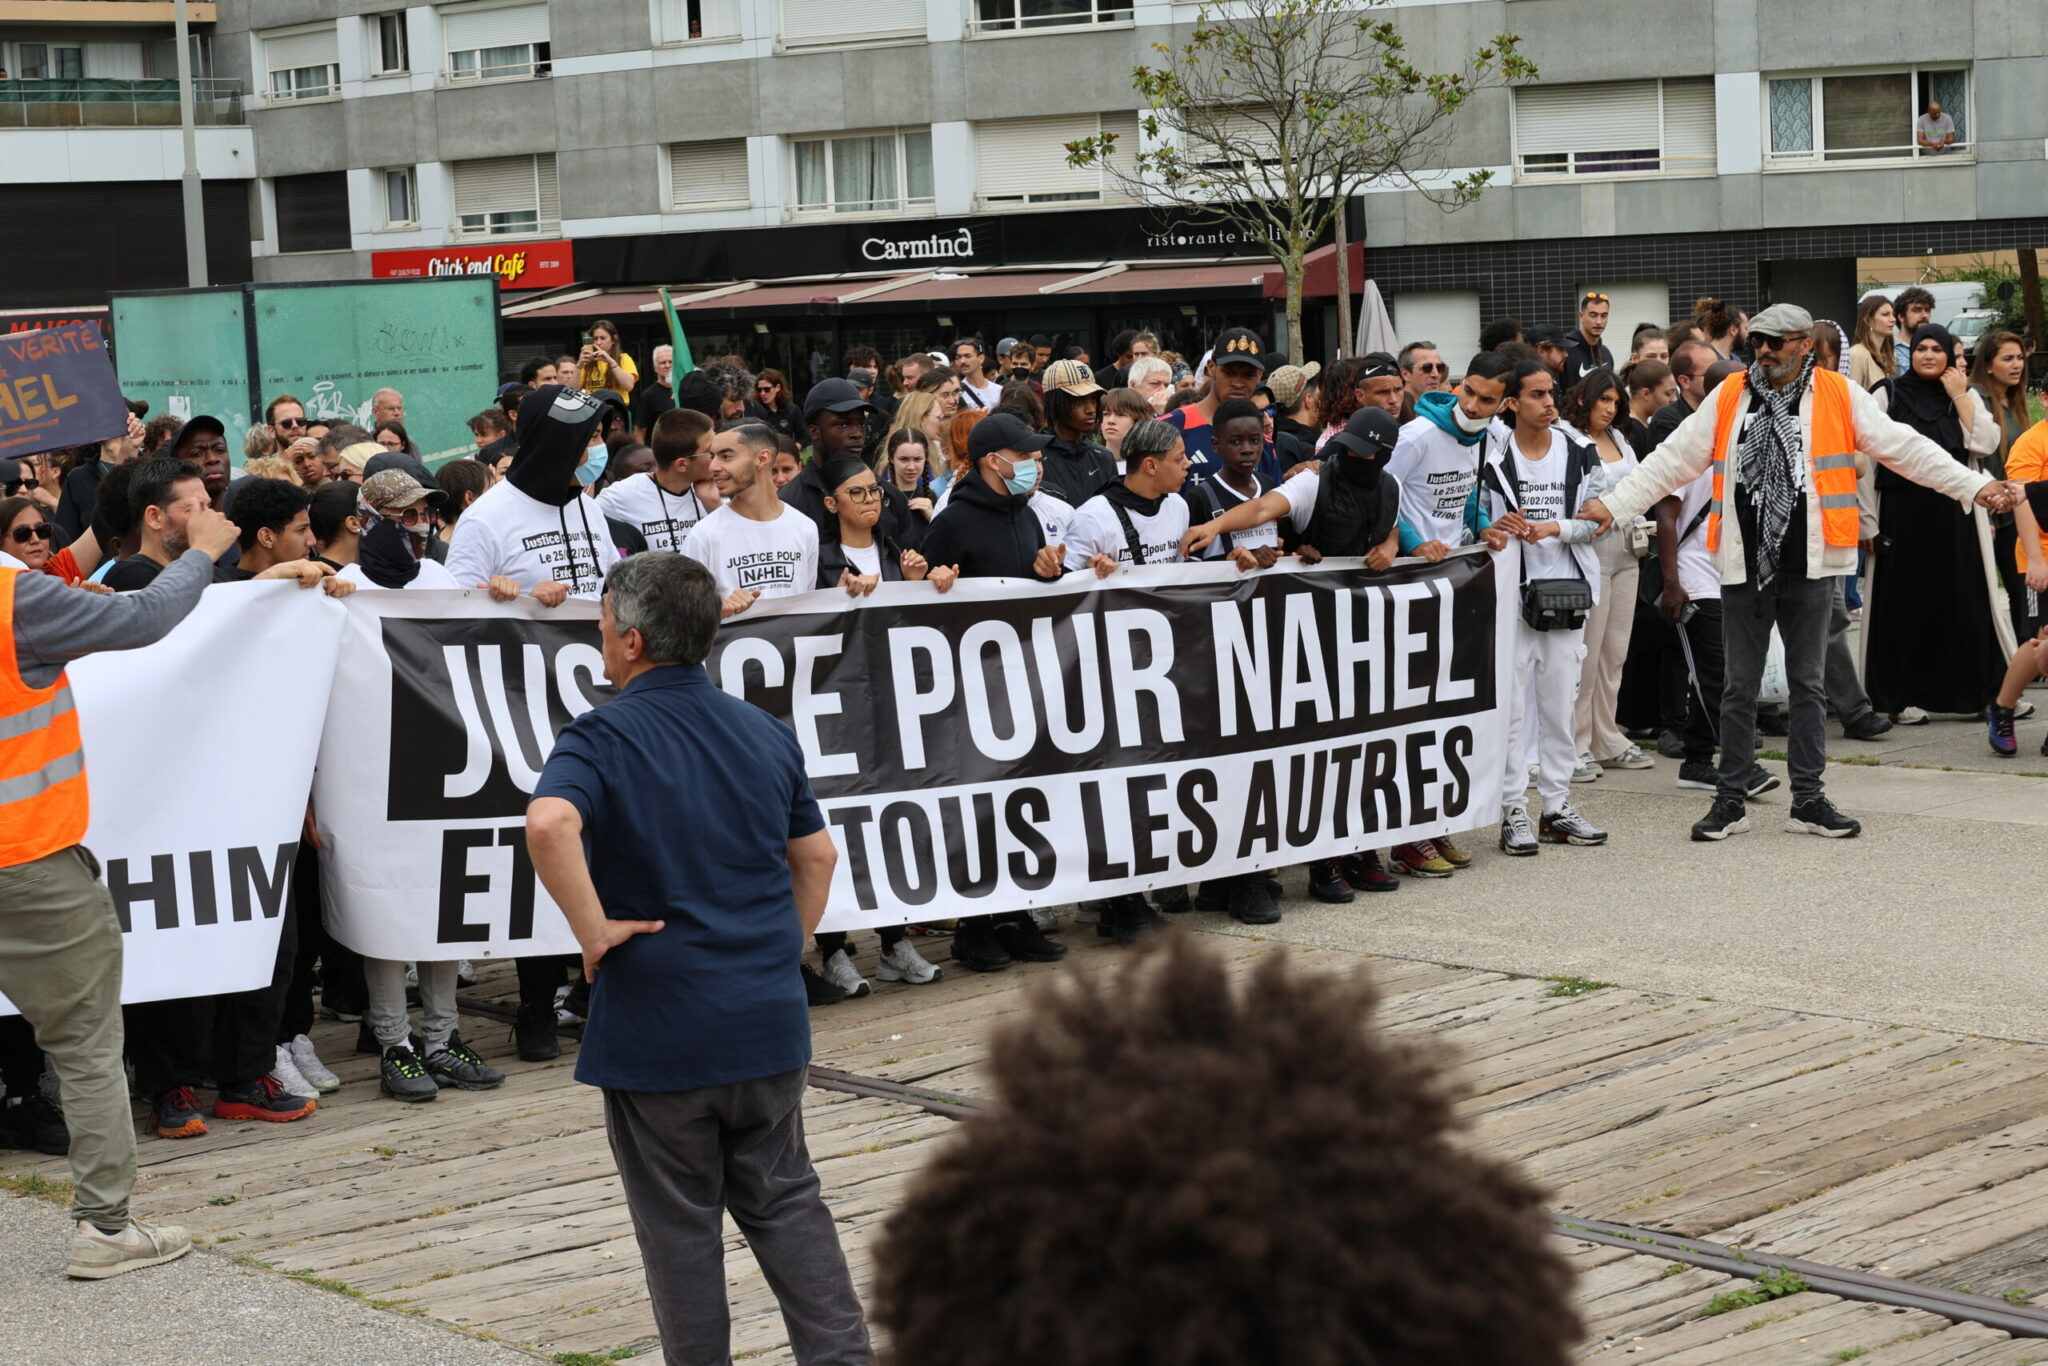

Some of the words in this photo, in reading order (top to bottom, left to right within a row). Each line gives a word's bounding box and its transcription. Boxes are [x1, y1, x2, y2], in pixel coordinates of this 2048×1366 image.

[1147, 229, 1236, 247] ristorante
[1243, 223, 1316, 243] itlio
[428, 256, 492, 276] Chick'end
[494, 251, 525, 281] Café
[1428, 473, 1458, 484] Justice
[1433, 488, 1444, 496] Le
[1529, 483, 1548, 493] pour
[1550, 510, 1557, 519] le
[644, 520, 678, 534] Justie
[524, 533, 561, 550] Justice
[656, 538, 669, 549] Le
[539, 553, 552, 564] Le
[1119, 547, 1147, 561] Juse
[1149, 543, 1166, 557] pour
[727, 552, 773, 569] JUSTICE
[777, 551, 801, 561] POUR
[589, 564, 597, 575] le
[744, 566, 790, 583] NAHEL
[442, 633, 860, 799] JUSCE
[887, 608, 1185, 770] POUR
[1211, 577, 1476, 737] NAHEL
[437, 826, 535, 944] ET
[829, 786, 1057, 911] TOUS
[1080, 768, 1218, 882] LES
[1237, 725, 1474, 858] AUTRES
